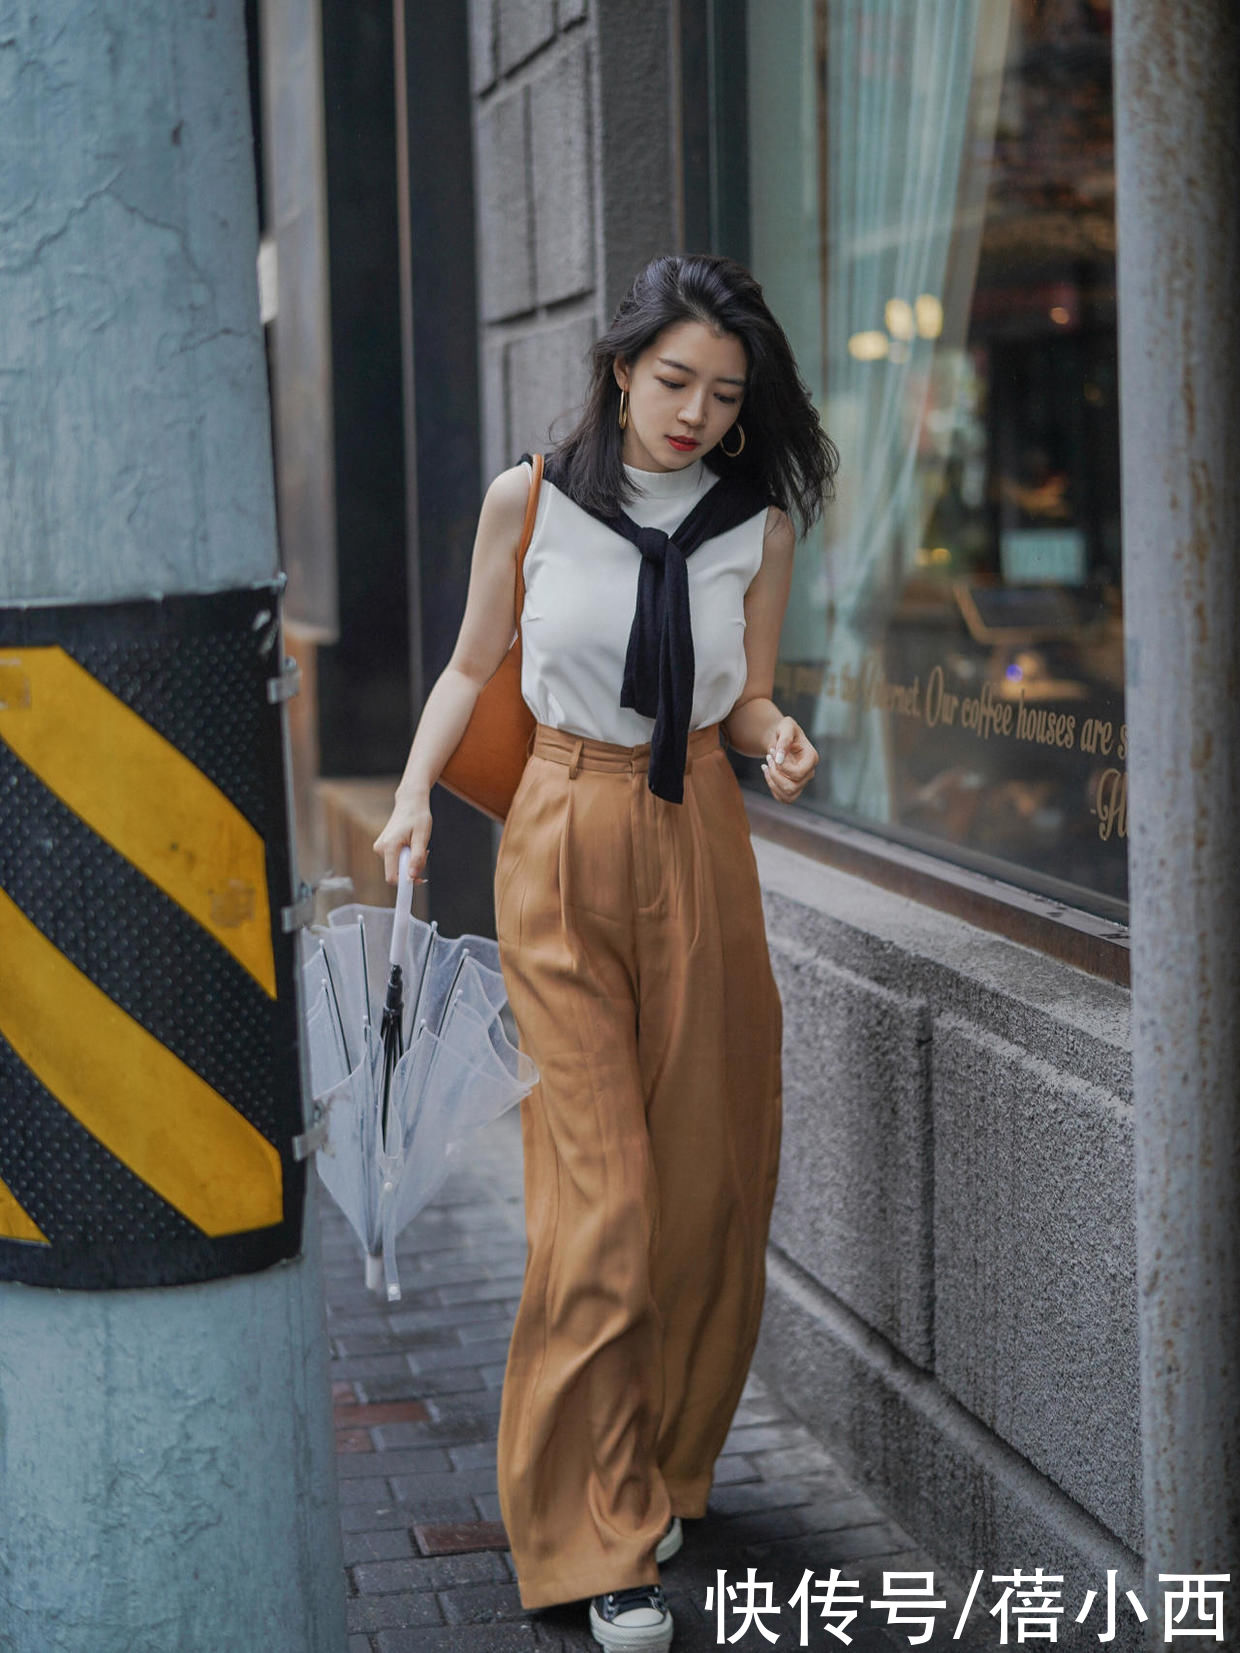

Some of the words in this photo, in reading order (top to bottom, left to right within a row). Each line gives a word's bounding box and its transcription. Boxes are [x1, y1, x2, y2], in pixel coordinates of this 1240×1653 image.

[925, 665, 958, 727] Our
[961, 681, 1014, 739] coffee
[1016, 689, 1075, 749] houses
[1080, 717, 1113, 756] are
